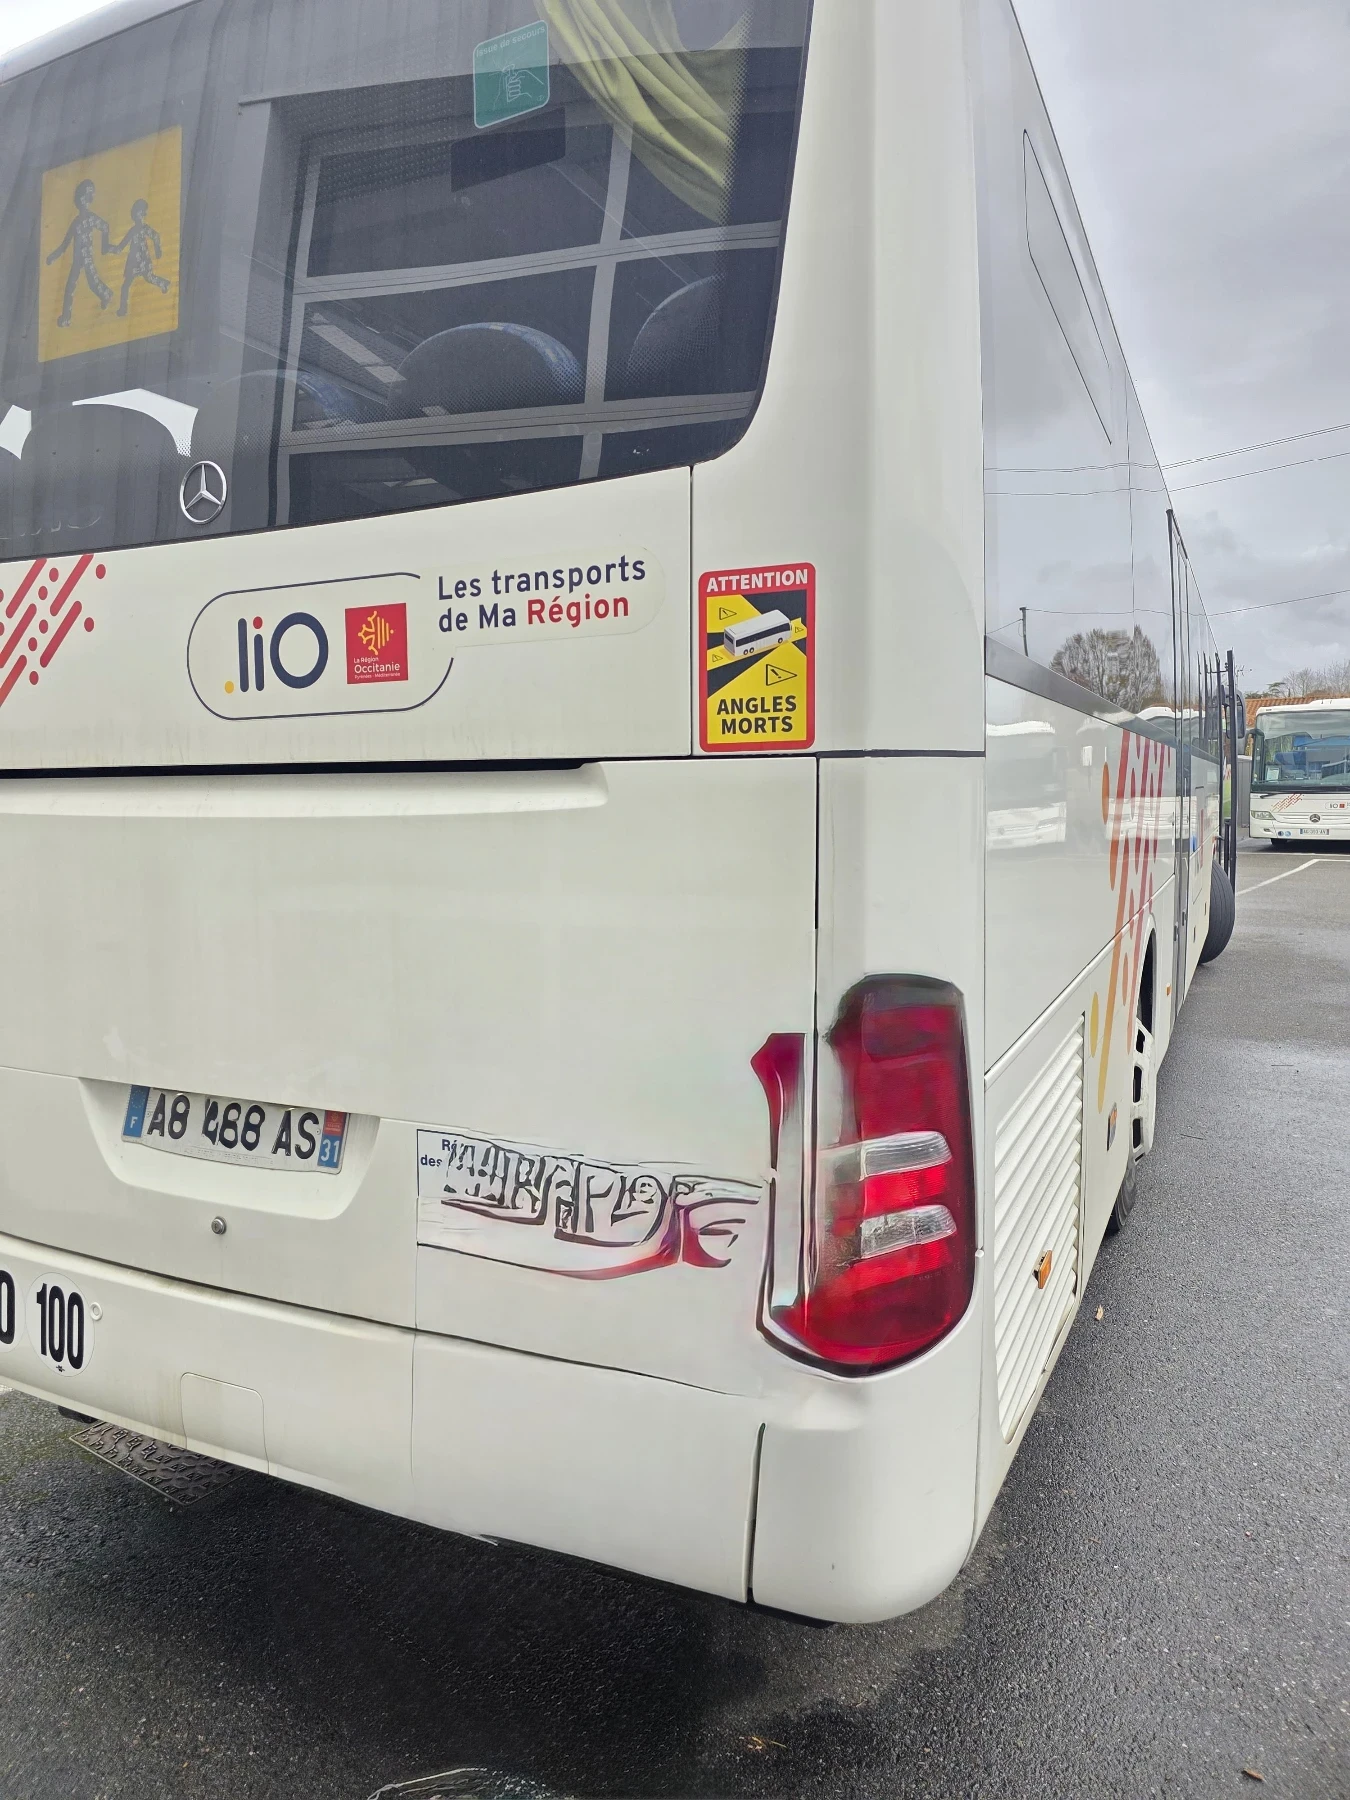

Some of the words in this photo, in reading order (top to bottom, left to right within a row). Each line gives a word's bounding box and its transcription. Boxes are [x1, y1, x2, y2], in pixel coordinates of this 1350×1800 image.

[500, 38, 511, 49] de
[512, 26, 546, 44] secours
[438, 575, 482, 601] Les
[492, 555, 647, 598] transports
[706, 568, 809, 593] ATTENTION
[439, 607, 469, 633] de
[480, 603, 517, 629] Ma
[526, 594, 630, 627] Région
[354, 662, 401, 674] Occitanie
[360, 656, 379, 664] Région
[716, 695, 797, 715] ANGLES
[721, 715, 793, 735] MORTS
[130, 1116, 138, 1129] F
[271, 1109, 320, 1160] AS
[320, 1138, 340, 1163] 31
[36, 1282, 85, 1369] 100
